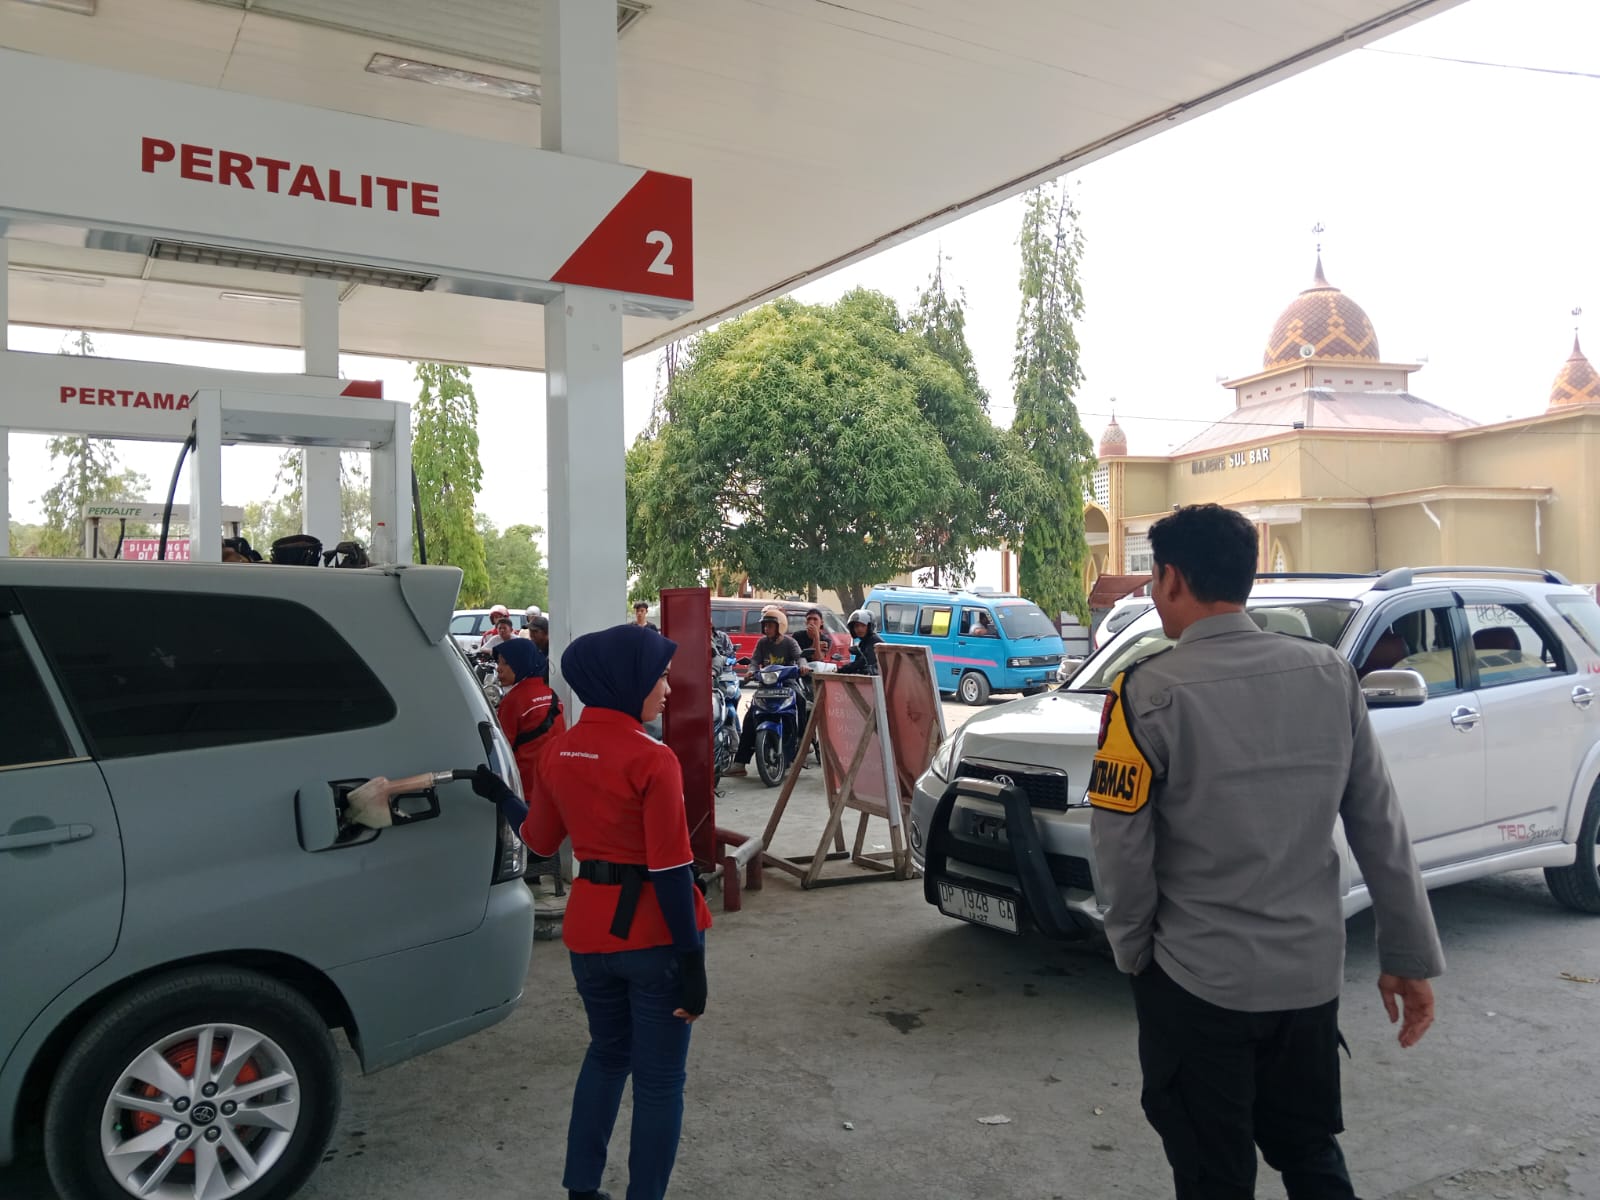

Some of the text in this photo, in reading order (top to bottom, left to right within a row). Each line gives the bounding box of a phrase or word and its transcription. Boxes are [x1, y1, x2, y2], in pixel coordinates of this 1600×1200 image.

[141, 136, 440, 217] PERTALITE
[645, 230, 674, 276] 2
[60, 386, 190, 411] PERTAMA
[1228, 452, 1246, 469] SUL
[1249, 447, 1271, 464] BAR
[88, 506, 142, 516] PERTALITE
[142, 543, 180, 552] LARNG
[151, 551, 189, 560] AEAL
[941, 884, 1015, 922] DP 1948 GA
